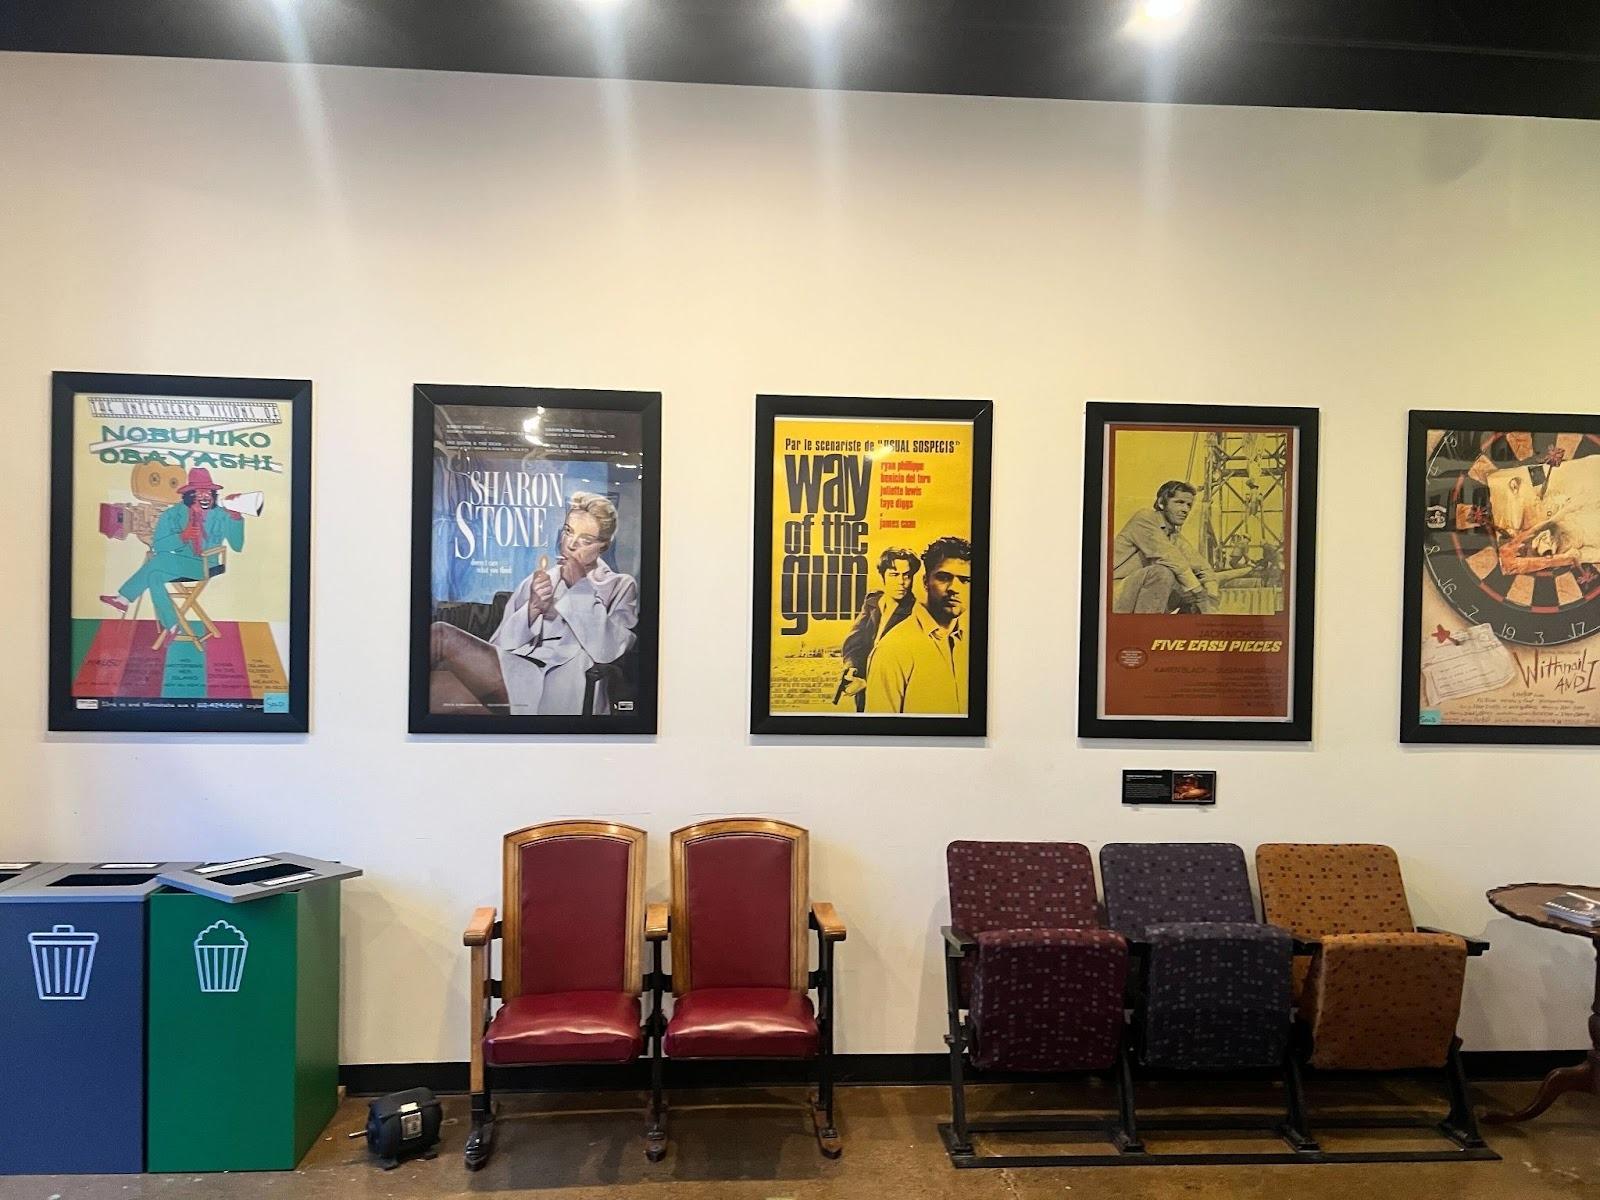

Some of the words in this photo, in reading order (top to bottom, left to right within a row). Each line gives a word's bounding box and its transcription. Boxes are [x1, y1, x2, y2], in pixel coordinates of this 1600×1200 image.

[102, 425, 272, 448] NOBUHIKO
[785, 438, 801, 451] Par
[804, 438, 812, 451] le
[815, 440, 862, 452] scenariste
[865, 440, 875, 452] de
[100, 449, 273, 471] OBAYASHI
[469, 470, 564, 508] SHARON
[784, 454, 873, 521] way
[454, 500, 549, 559] STONE
[784, 514, 815, 555] of
[822, 514, 868, 555] the
[781, 555, 868, 636] gun
[1438, 577, 1458, 597] 16
[1500, 622, 1517, 641] 19
[1533, 631, 1545, 646] 3
[1567, 621, 1586, 640] 17
[1151, 639, 1188, 651] FIVE
[1187, 640, 1229, 652] EASY
[1228, 640, 1283, 653] PIECES
[1512, 648, 1587, 689] Withnail
[1554, 675, 1585, 694] AND
[1577, 659, 1600, 694] I
